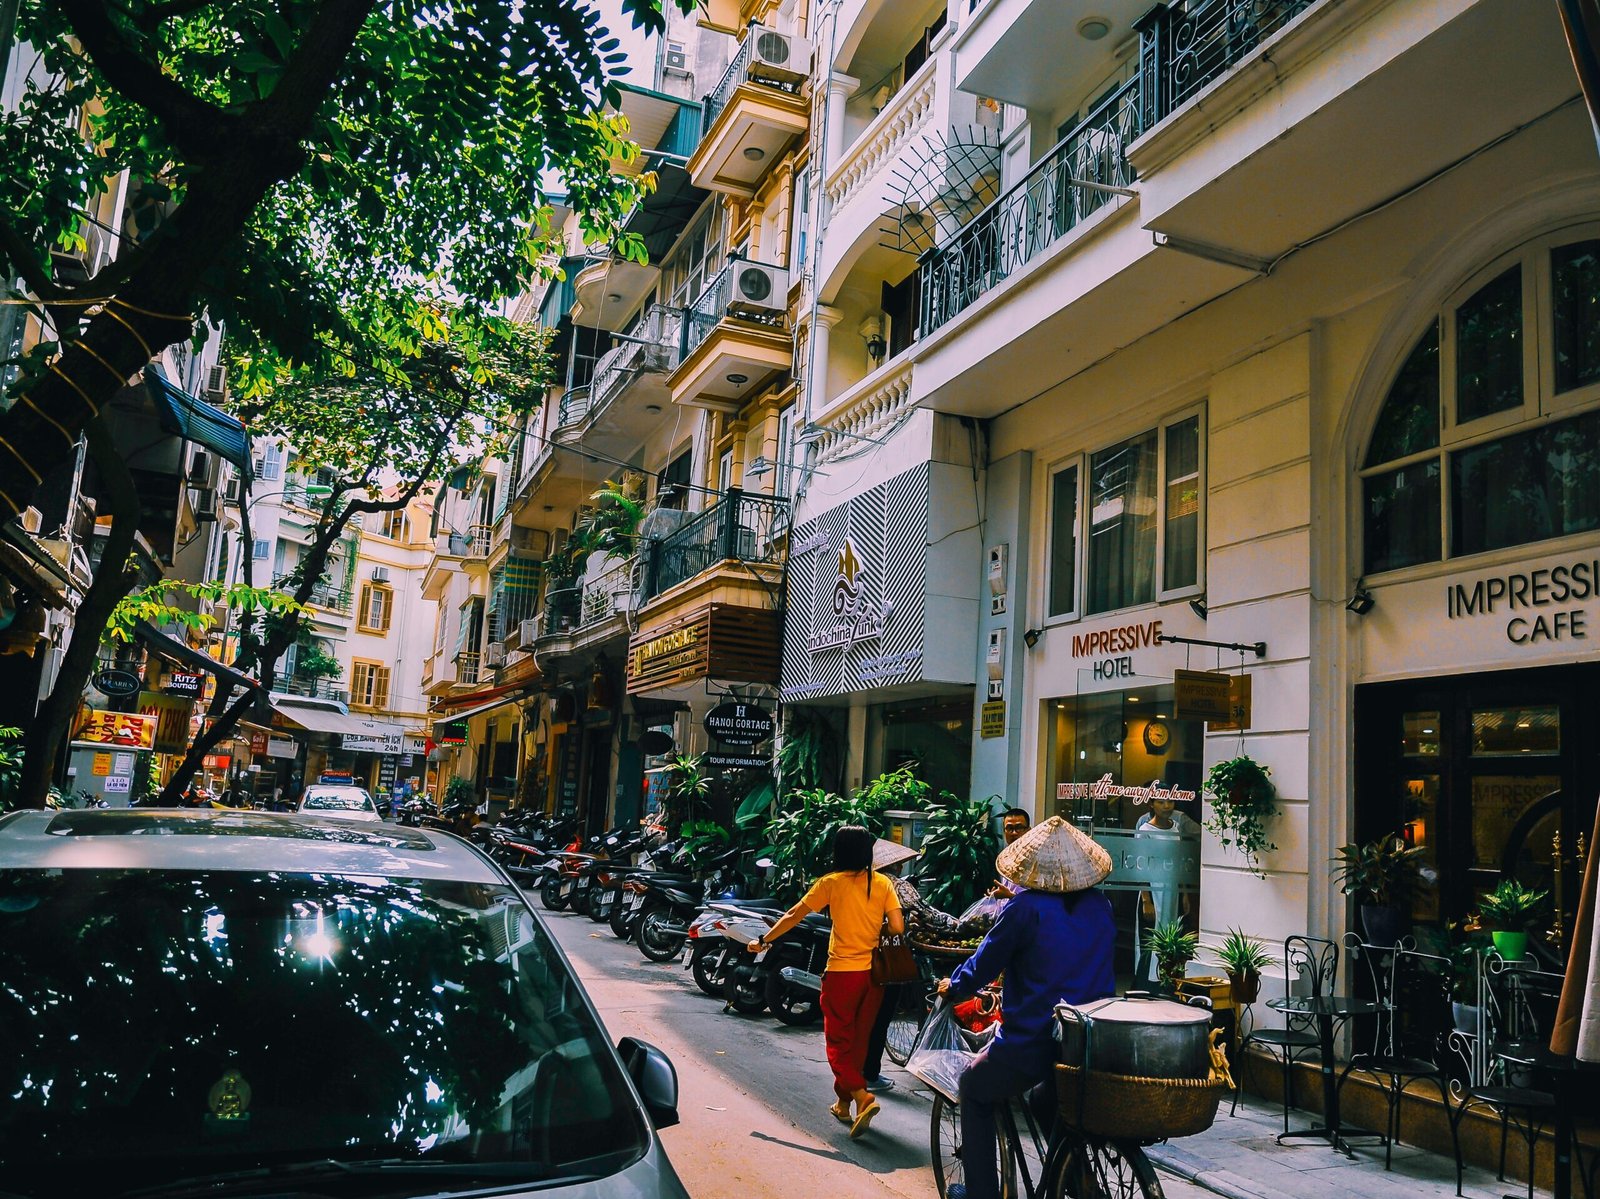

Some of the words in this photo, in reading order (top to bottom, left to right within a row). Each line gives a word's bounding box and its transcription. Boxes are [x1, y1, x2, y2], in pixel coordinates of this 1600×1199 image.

[1447, 559, 1600, 618] IMPRESSI
[1506, 609, 1585, 644] CAFE
[1071, 620, 1163, 658] IMPRESSIVE
[1093, 655, 1136, 680] HOTEL
[174, 674, 197, 684] RITZ
[1180, 684, 1228, 698] IMPRESSIVE
[1191, 698, 1217, 710] HOTEL
[709, 716, 734, 728] HANOI
[735, 718, 771, 730] GORTAGE
[384, 744, 399, 752] 24h
[726, 757, 766, 767] INFORMATION
[1095, 773, 1124, 798] Home
[1124, 785, 1146, 806] away
[1168, 783, 1196, 802] home
[1112, 849, 1174, 871] elcome
